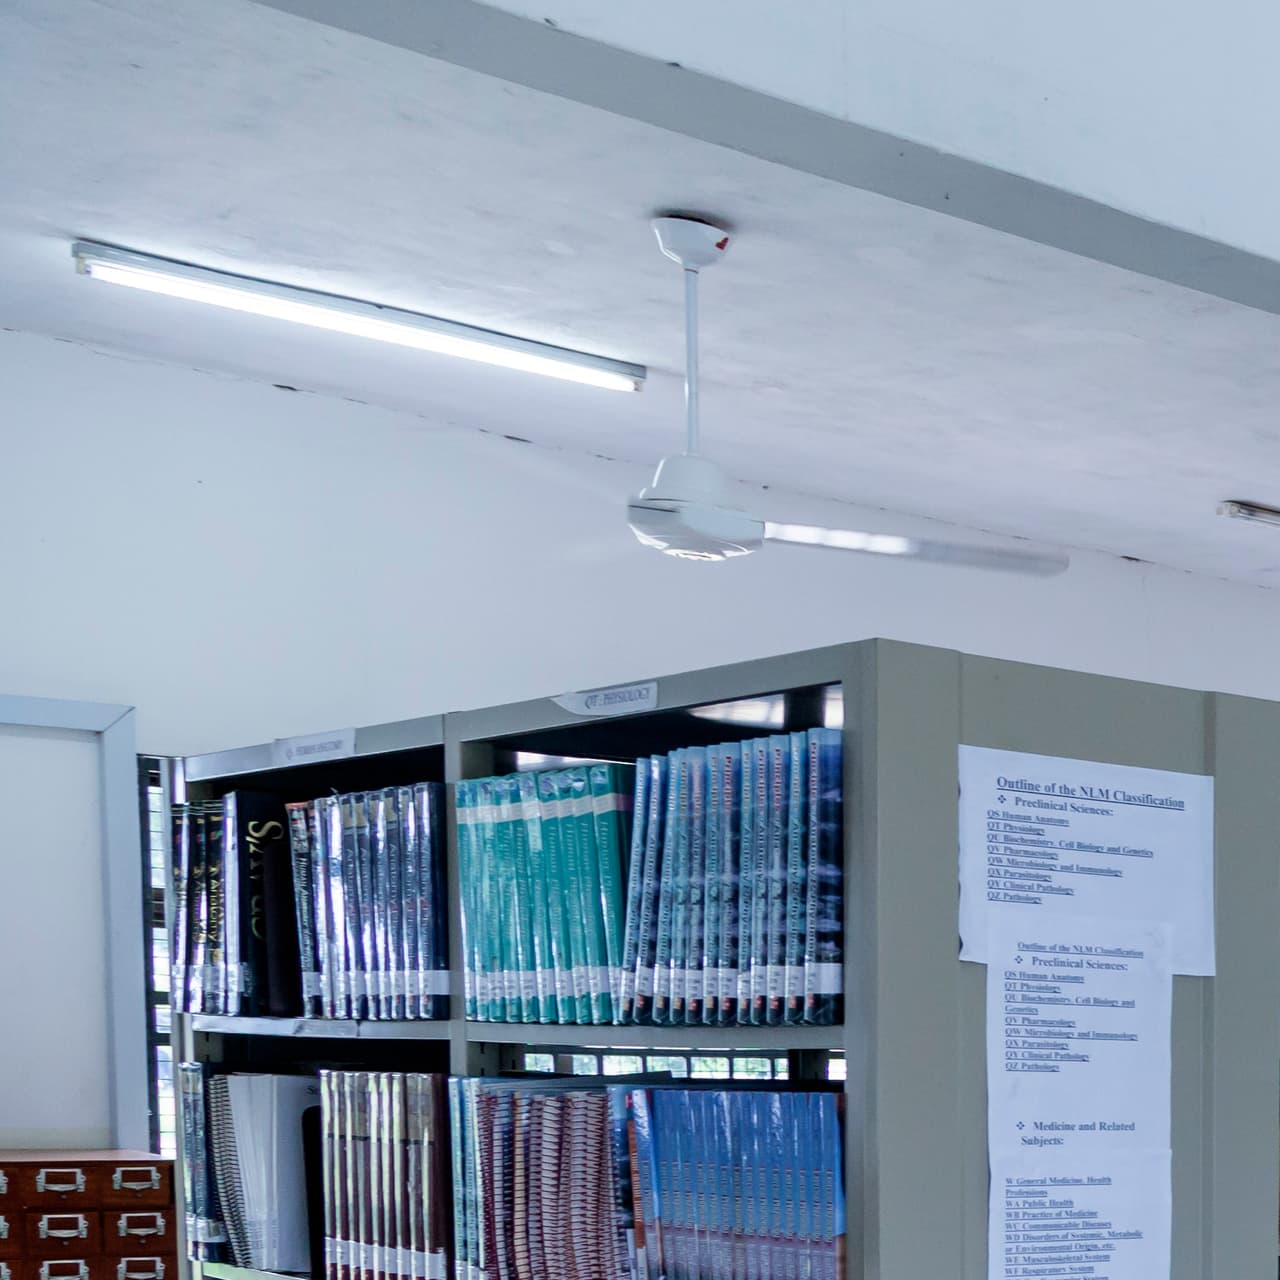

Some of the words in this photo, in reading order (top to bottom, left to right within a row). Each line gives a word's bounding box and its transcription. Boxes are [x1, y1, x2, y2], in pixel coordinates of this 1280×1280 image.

[997, 776, 1041, 793] Outline
[1044, 783, 1057, 795] of
[1059, 785, 1076, 796] the
[1079, 787, 1109, 800] NLM
[1113, 790, 1184, 809] Classification
[1015, 796, 1067, 811] Preclinical
[1070, 802, 1113, 816] Sciences:
[1032, 956, 1083, 969] Preclinical
[1085, 959, 1128, 971] Sciences:
[1033, 1121, 1076, 1131] Medicine
[1078, 1122, 1096, 1131] and
[1099, 1121, 1136, 1131] Related
[1021, 1135, 1064, 1148] Subjects:
